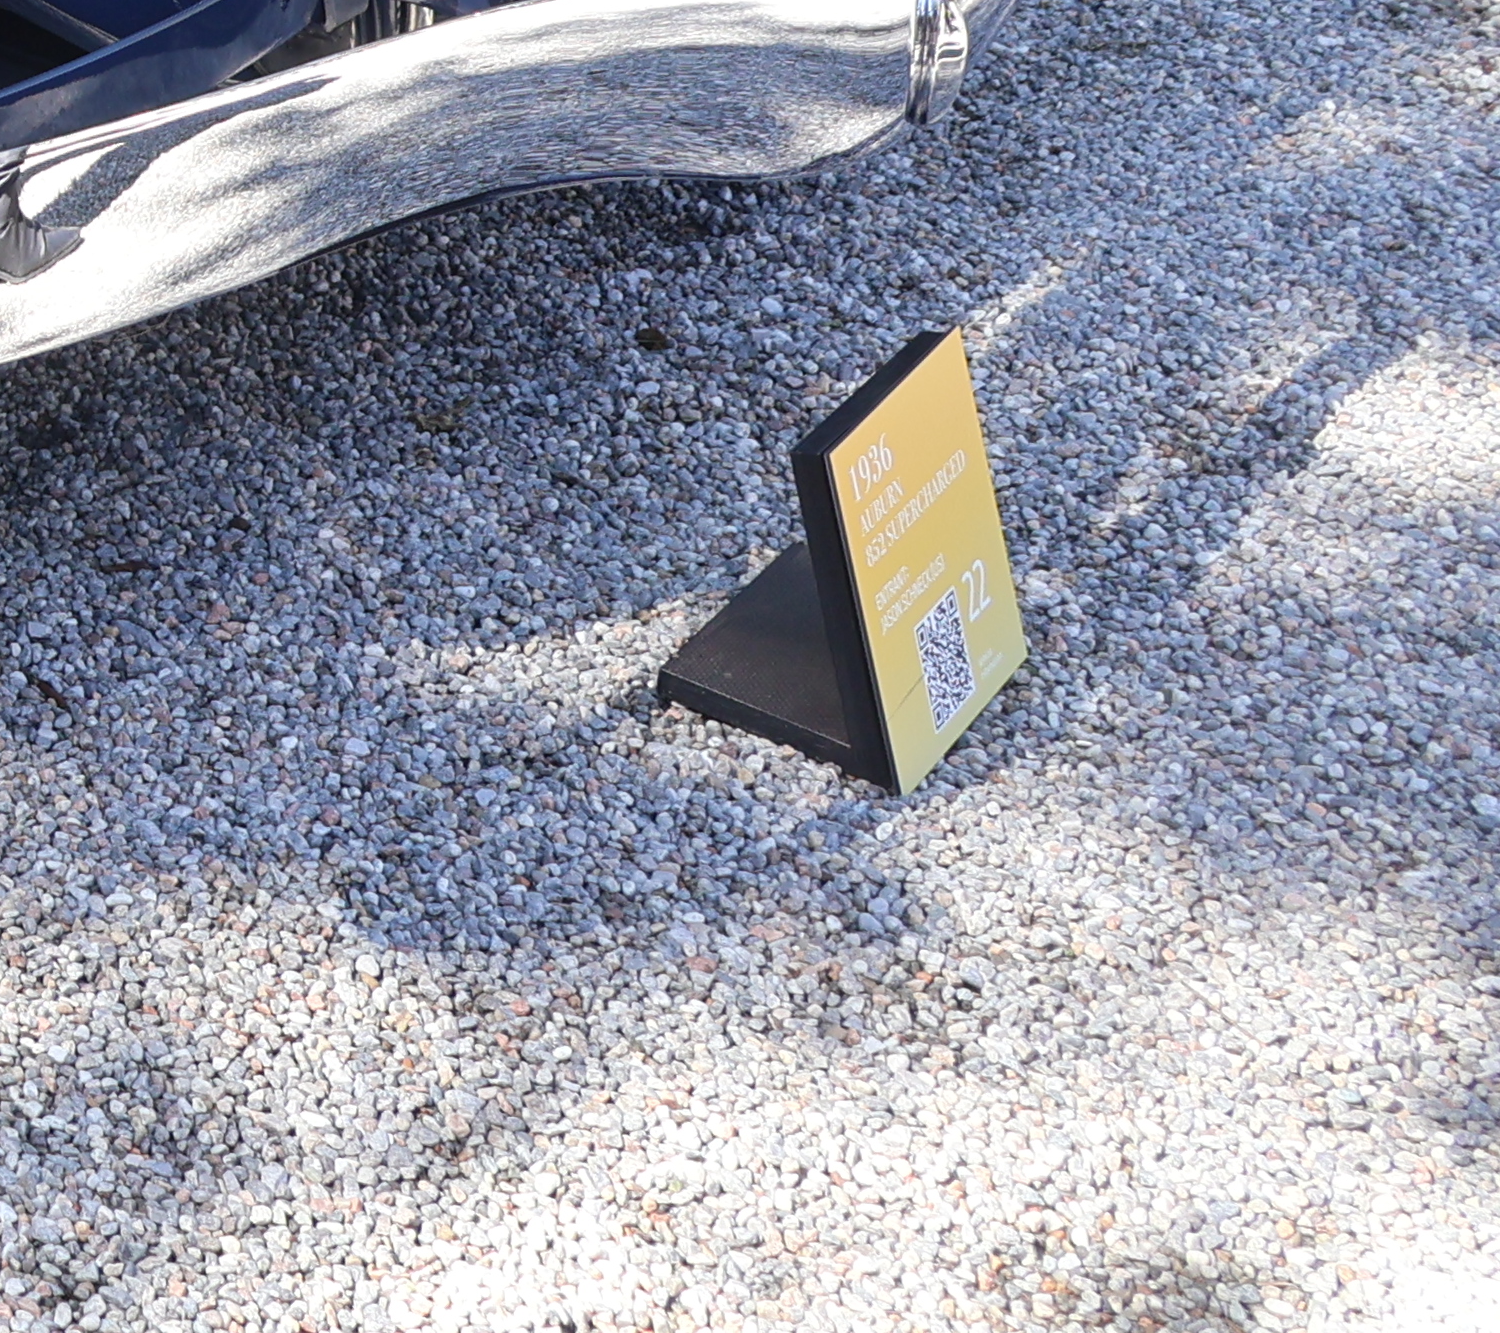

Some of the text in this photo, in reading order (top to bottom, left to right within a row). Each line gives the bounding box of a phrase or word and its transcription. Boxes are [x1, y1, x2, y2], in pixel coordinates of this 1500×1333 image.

[849, 432, 893, 502] 1936
[859, 477, 905, 537] AUBURN
[864, 449, 966, 568] 852 SUPERCHARGED
[961, 558, 992, 623] 22
